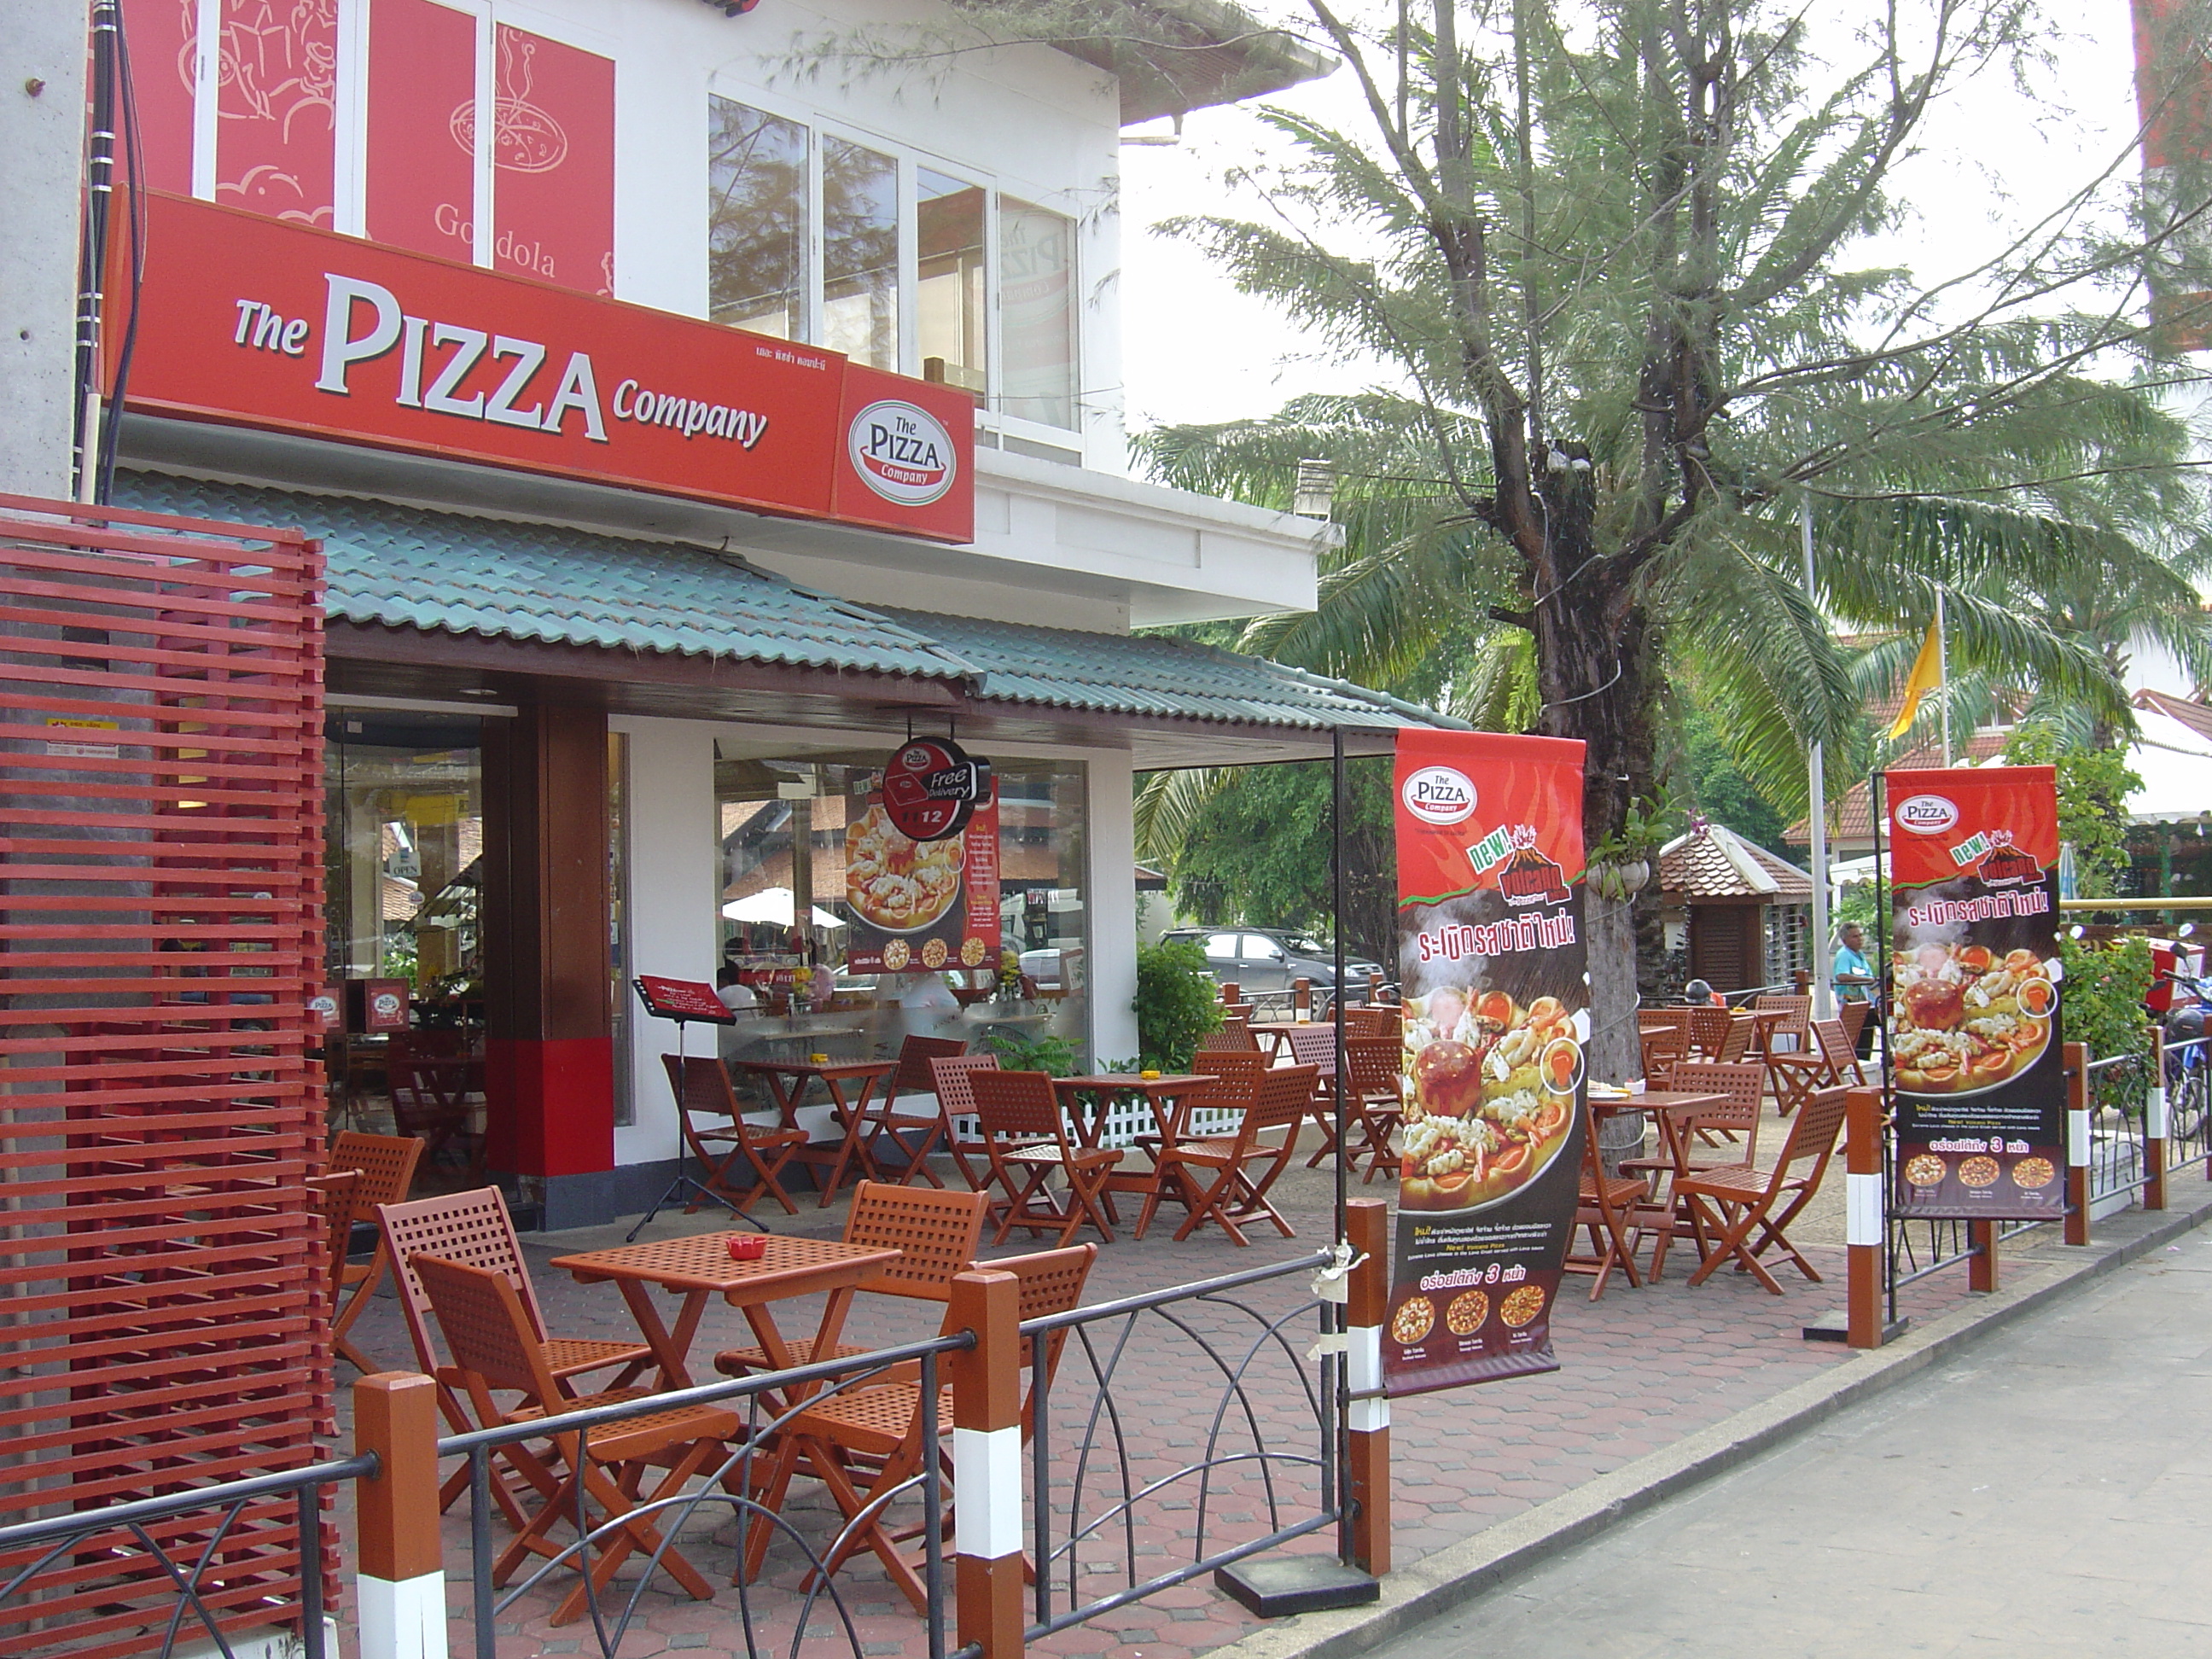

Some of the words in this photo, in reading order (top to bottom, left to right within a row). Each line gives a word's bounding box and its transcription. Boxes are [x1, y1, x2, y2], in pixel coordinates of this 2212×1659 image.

[434, 203, 556, 278] Godola
[235, 299, 308, 355] The
[314, 272, 608, 443] PIZZA
[613, 378, 767, 449] Company
[895, 416, 917, 435] The
[870, 422, 940, 469] PIZZA
[881, 463, 928, 485] Company
[931, 768, 968, 788] Free
[1435, 775, 1450, 784] The
[928, 785, 970, 798] Delivery
[1417, 782, 1465, 802] PIZZA
[1424, 803, 1458, 812] Company
[1907, 806, 1947, 818] PIZZA
[393, 865, 417, 875] OPEN
[1990, 1136, 2002, 1152] 3
[1485, 1263, 1501, 1284] 3
